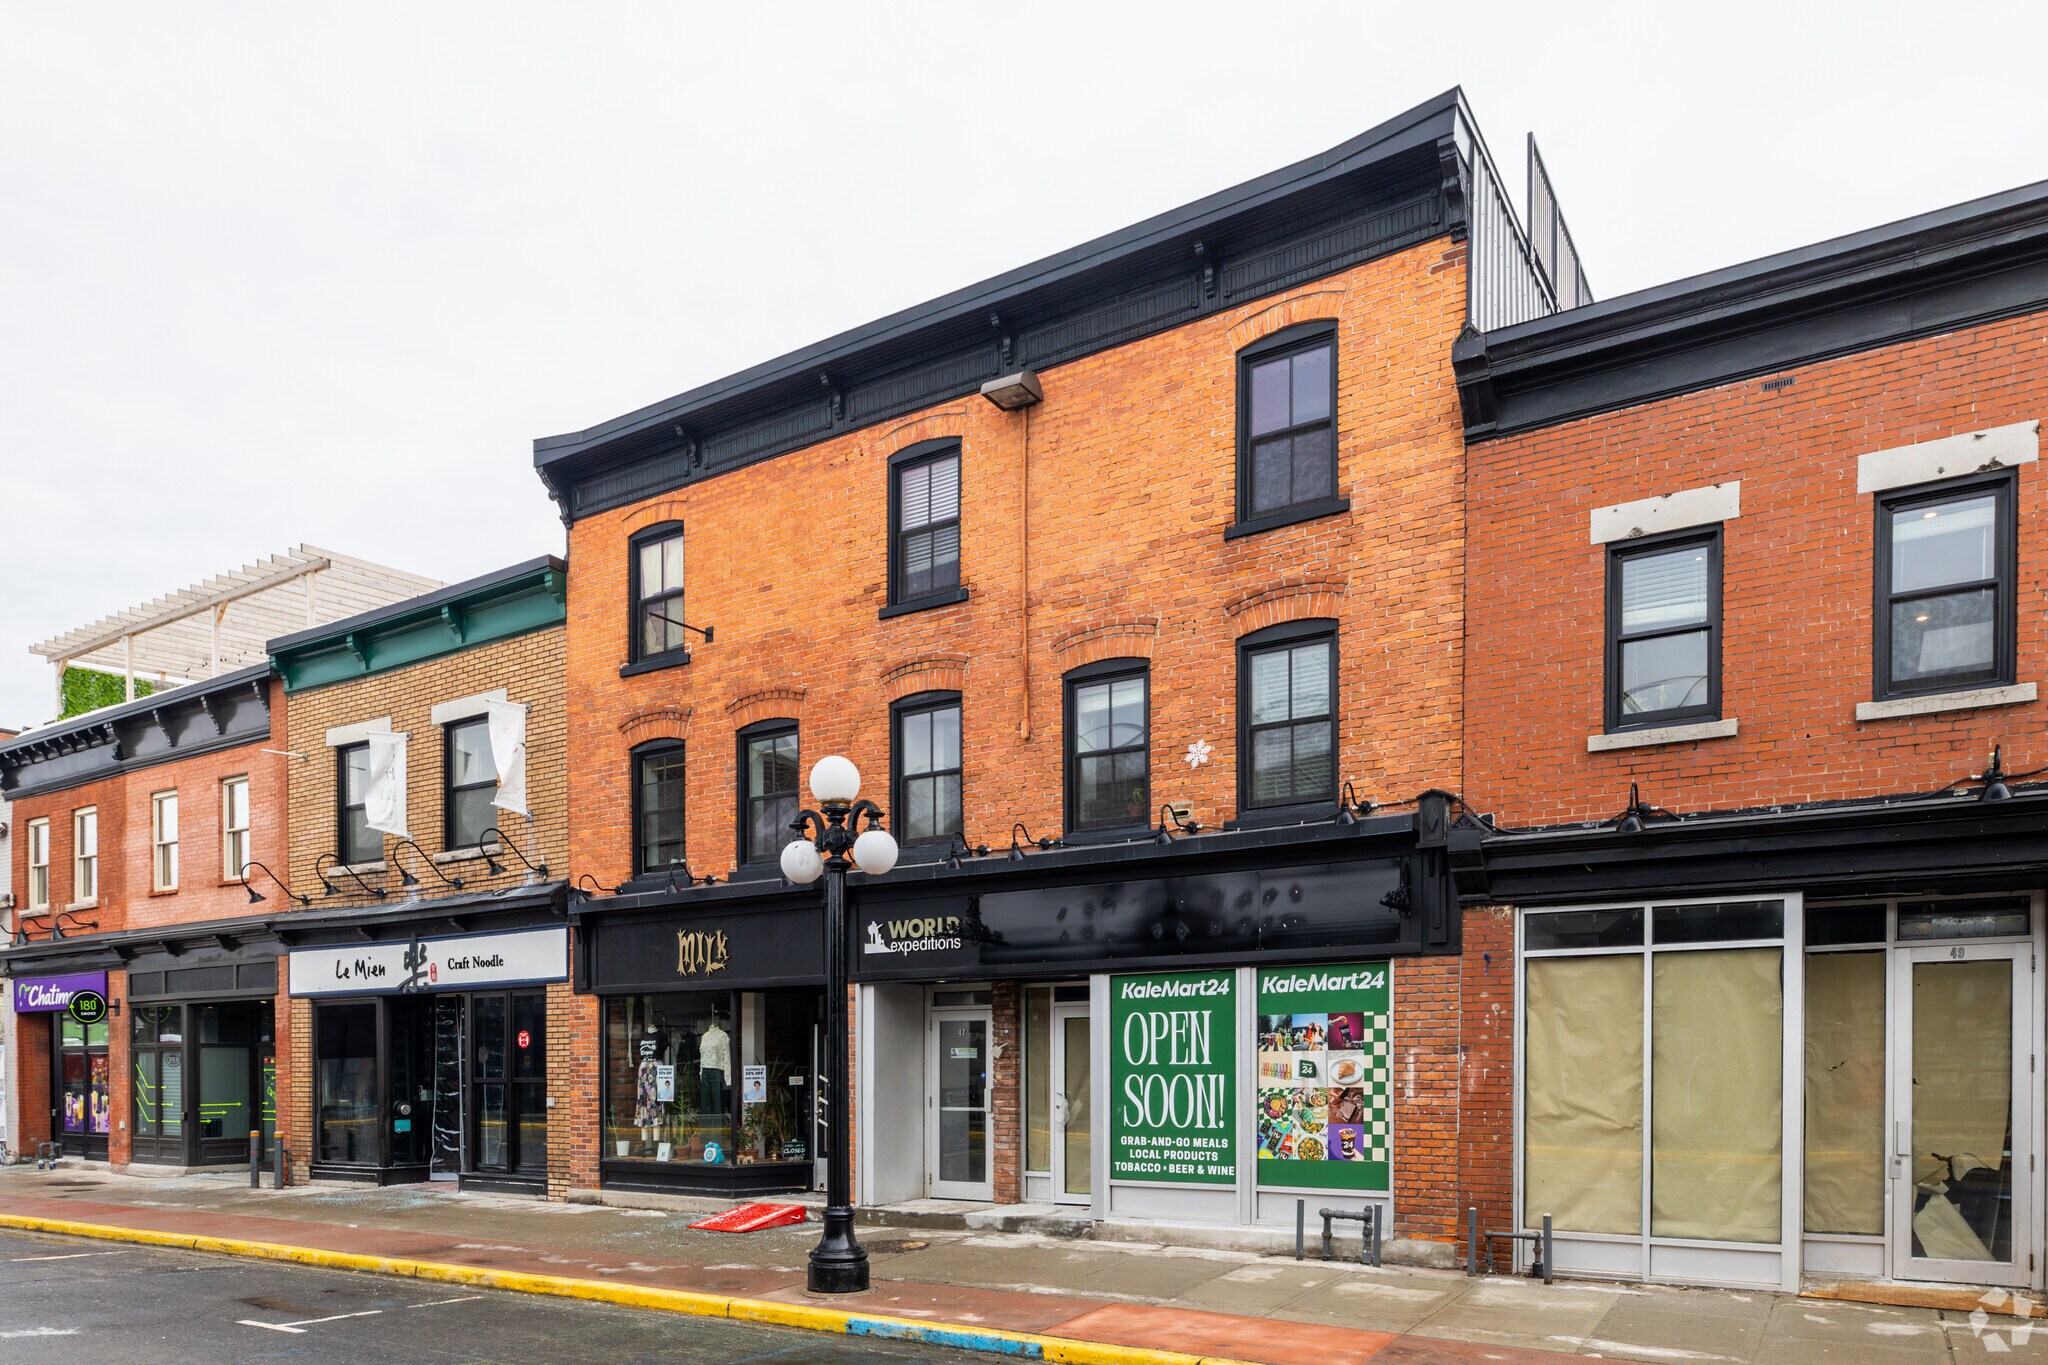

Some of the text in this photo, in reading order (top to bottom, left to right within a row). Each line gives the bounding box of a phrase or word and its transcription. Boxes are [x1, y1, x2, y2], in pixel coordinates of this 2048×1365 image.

[677, 928, 730, 977] MILK
[890, 936, 961, 957] expeditions
[1949, 946, 1965, 960] 49
[335, 956, 386, 980] Le Mien
[447, 954, 504, 970] Craft Noodle
[1121, 978, 1230, 999] KaleMart24
[1262, 971, 1385, 994] KaleMart24
[28, 983, 74, 1007] Chatim
[1123, 1010, 1213, 1066] OPEN
[1301, 1065, 1313, 1074] 24
[1123, 1073, 1225, 1129] SOON!
[783, 1147, 806, 1155] CLOSED
[1120, 1135, 1228, 1149] GRAB-AND-GO MEALS
[1129, 1148, 1219, 1161] LOCAL PRODUCTS
[1114, 1161, 1235, 1176] TOBACCO BEER & WINE
